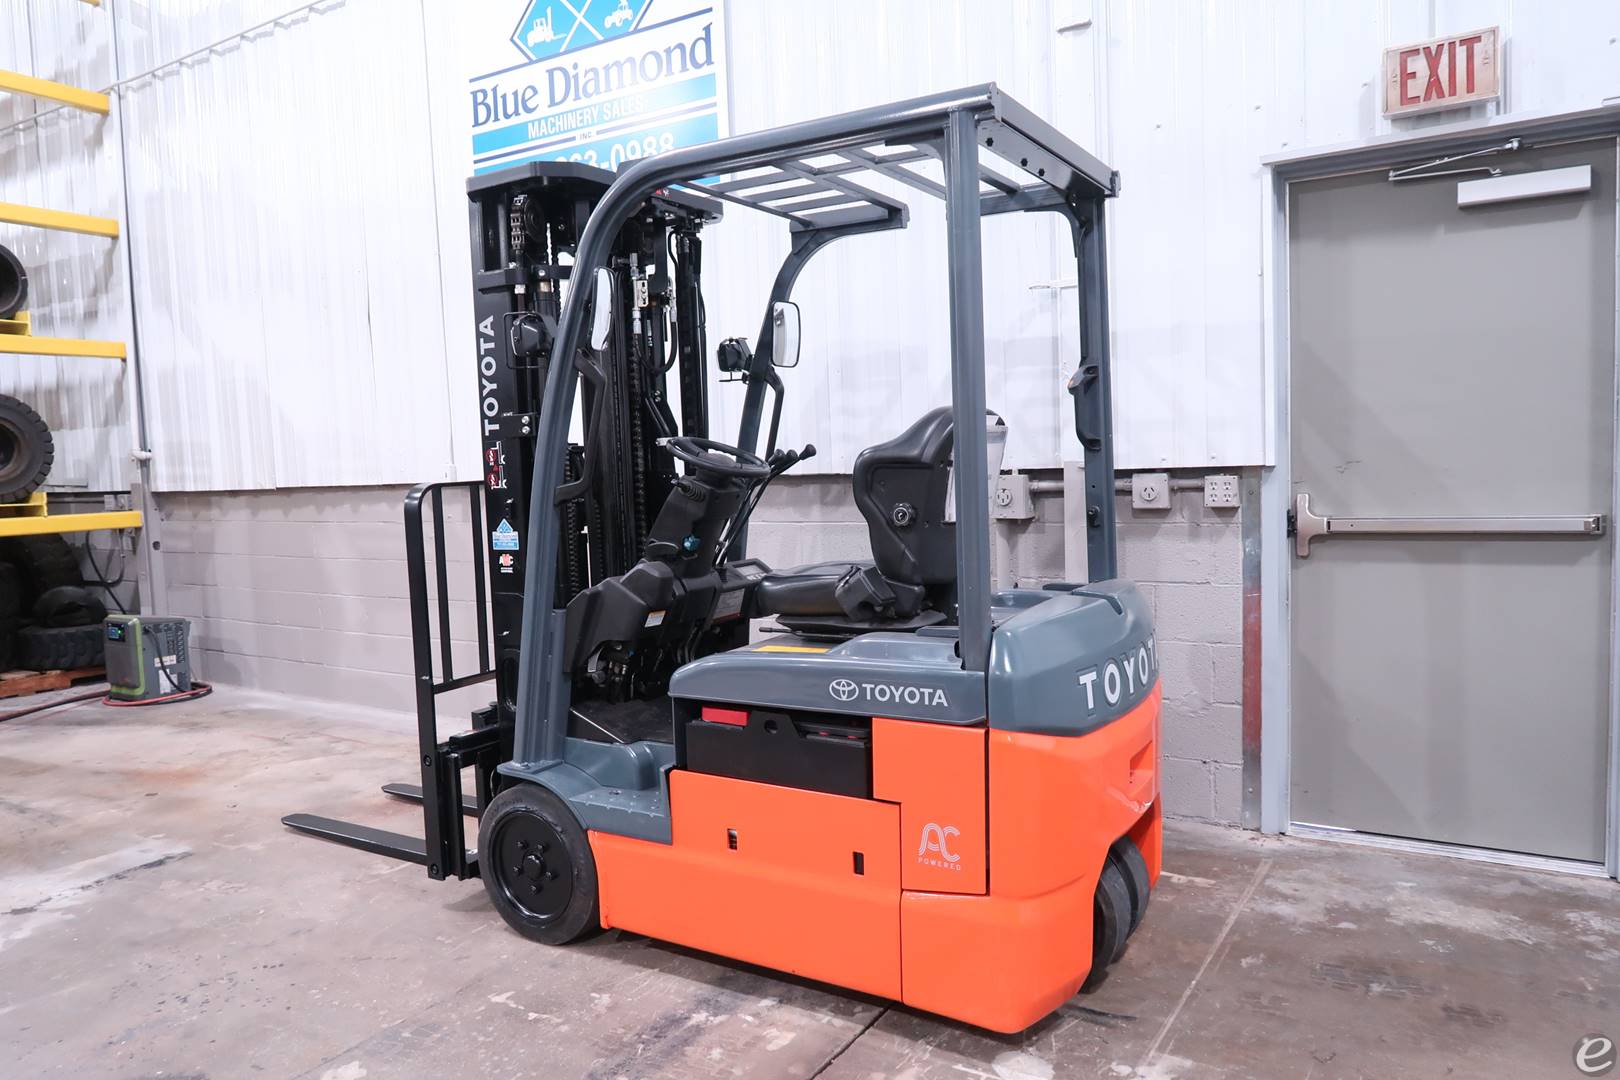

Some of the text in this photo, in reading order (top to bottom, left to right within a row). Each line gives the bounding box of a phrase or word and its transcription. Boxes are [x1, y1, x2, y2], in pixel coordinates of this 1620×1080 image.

[470, 22, 715, 128] Blue Diamond
[1400, 36, 1482, 106] EXIT
[528, 95, 644, 139] MACHINERY SALES
[479, 316, 500, 436] TOYOTA
[862, 683, 948, 707] TOYOTA
[1079, 638, 1158, 709] TOYOT
[918, 857, 961, 871] POWERED
[919, 823, 961, 862] AC
